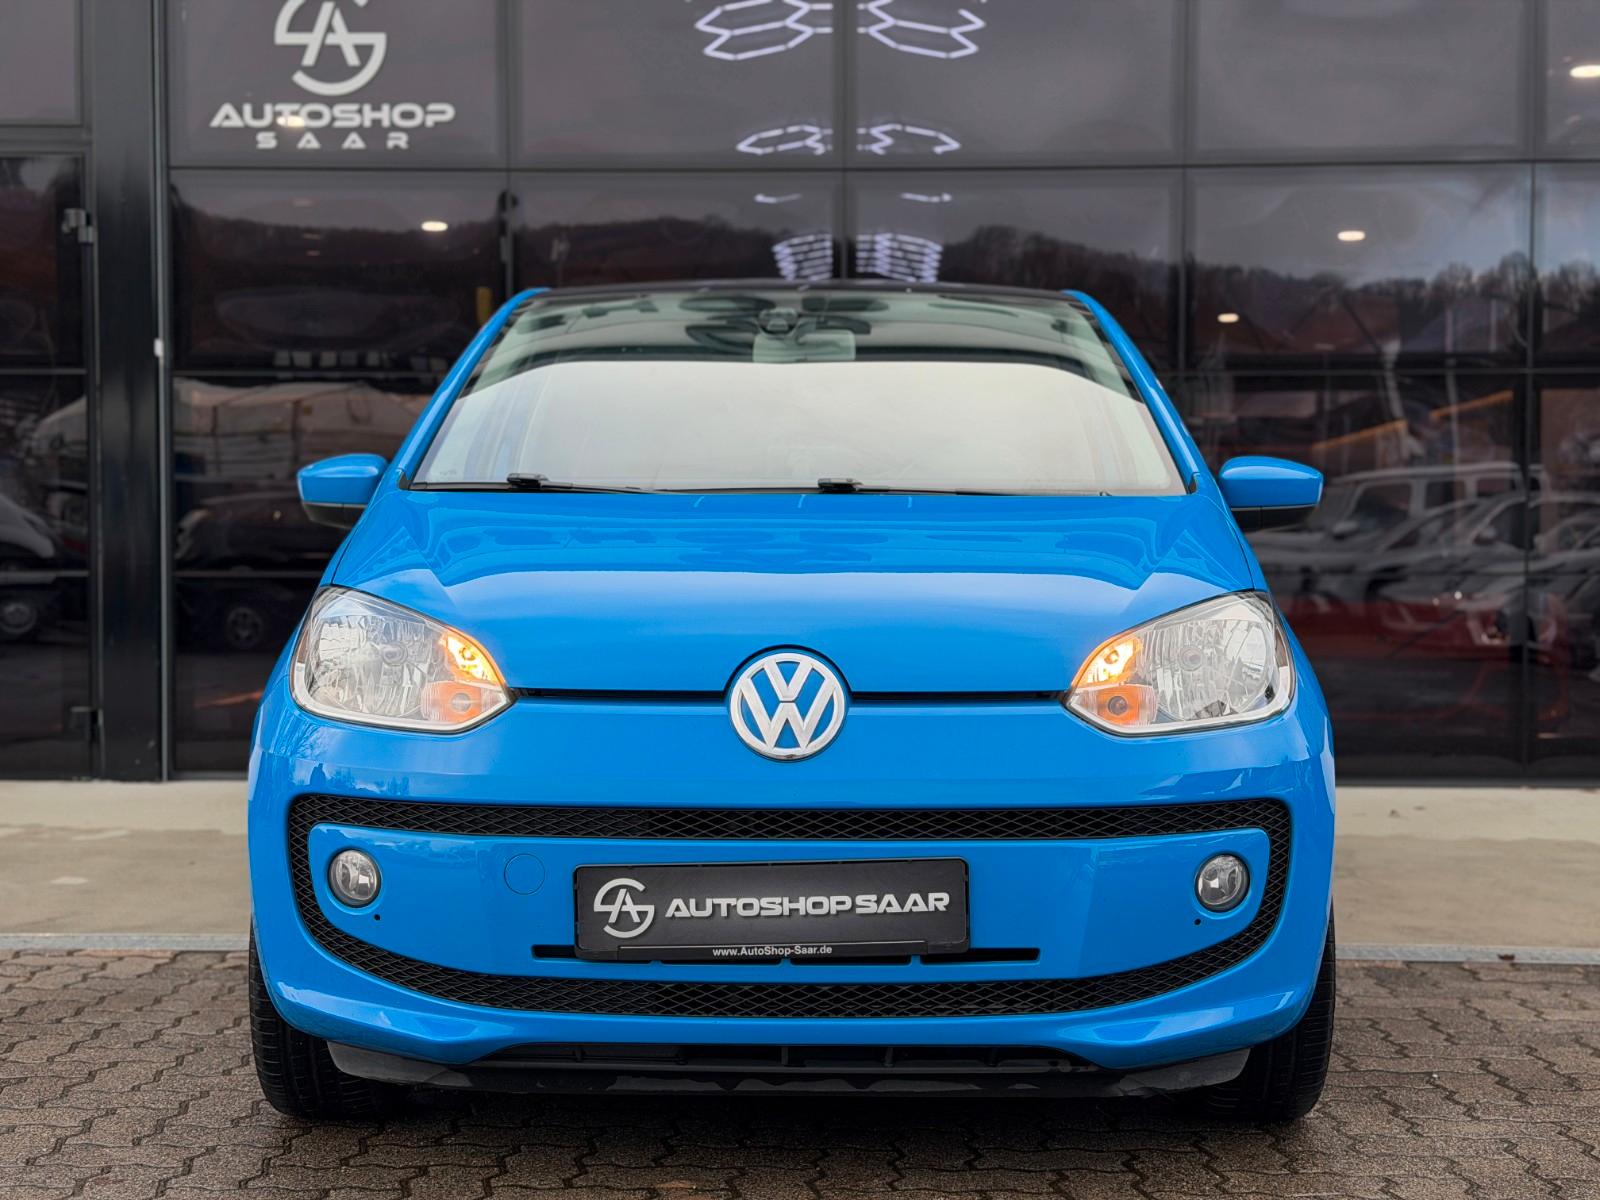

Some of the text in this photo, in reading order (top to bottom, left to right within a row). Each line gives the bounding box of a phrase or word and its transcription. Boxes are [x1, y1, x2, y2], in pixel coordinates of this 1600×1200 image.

[209, 102, 456, 128] AUTOSHOP
[255, 131, 409, 150] SAAR
[730, 653, 845, 760] VW
[712, 944, 833, 959] www.AutoShop-Saar.de
